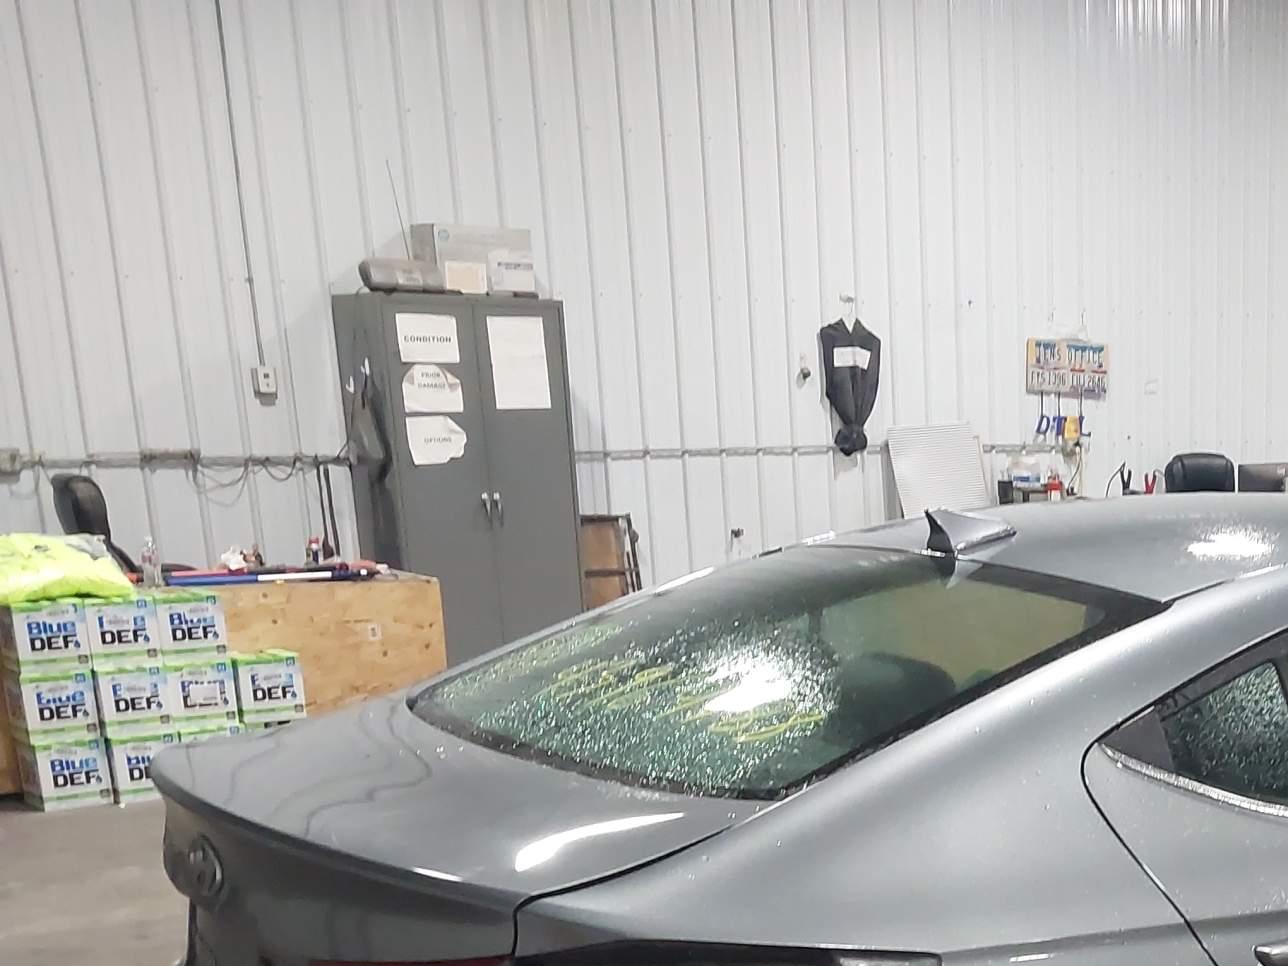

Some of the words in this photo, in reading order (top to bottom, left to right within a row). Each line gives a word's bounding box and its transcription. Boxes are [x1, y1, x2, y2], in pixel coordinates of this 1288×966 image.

[404, 334, 453, 344] CONDITION
[1066, 344, 1105, 365] OFFICE
[421, 371, 441, 379] PRIOR
[26, 620, 77, 636] Blue
[100, 628, 147, 645] DEF
[171, 623, 216, 642] DEF
[29, 634, 77, 652] DEF
[252, 684, 295, 702] DEF
[38, 702, 86, 722] DEF
[113, 695, 160, 713] DEF
[50, 757, 98, 773] Blue
[52, 768, 99, 789] DEF
